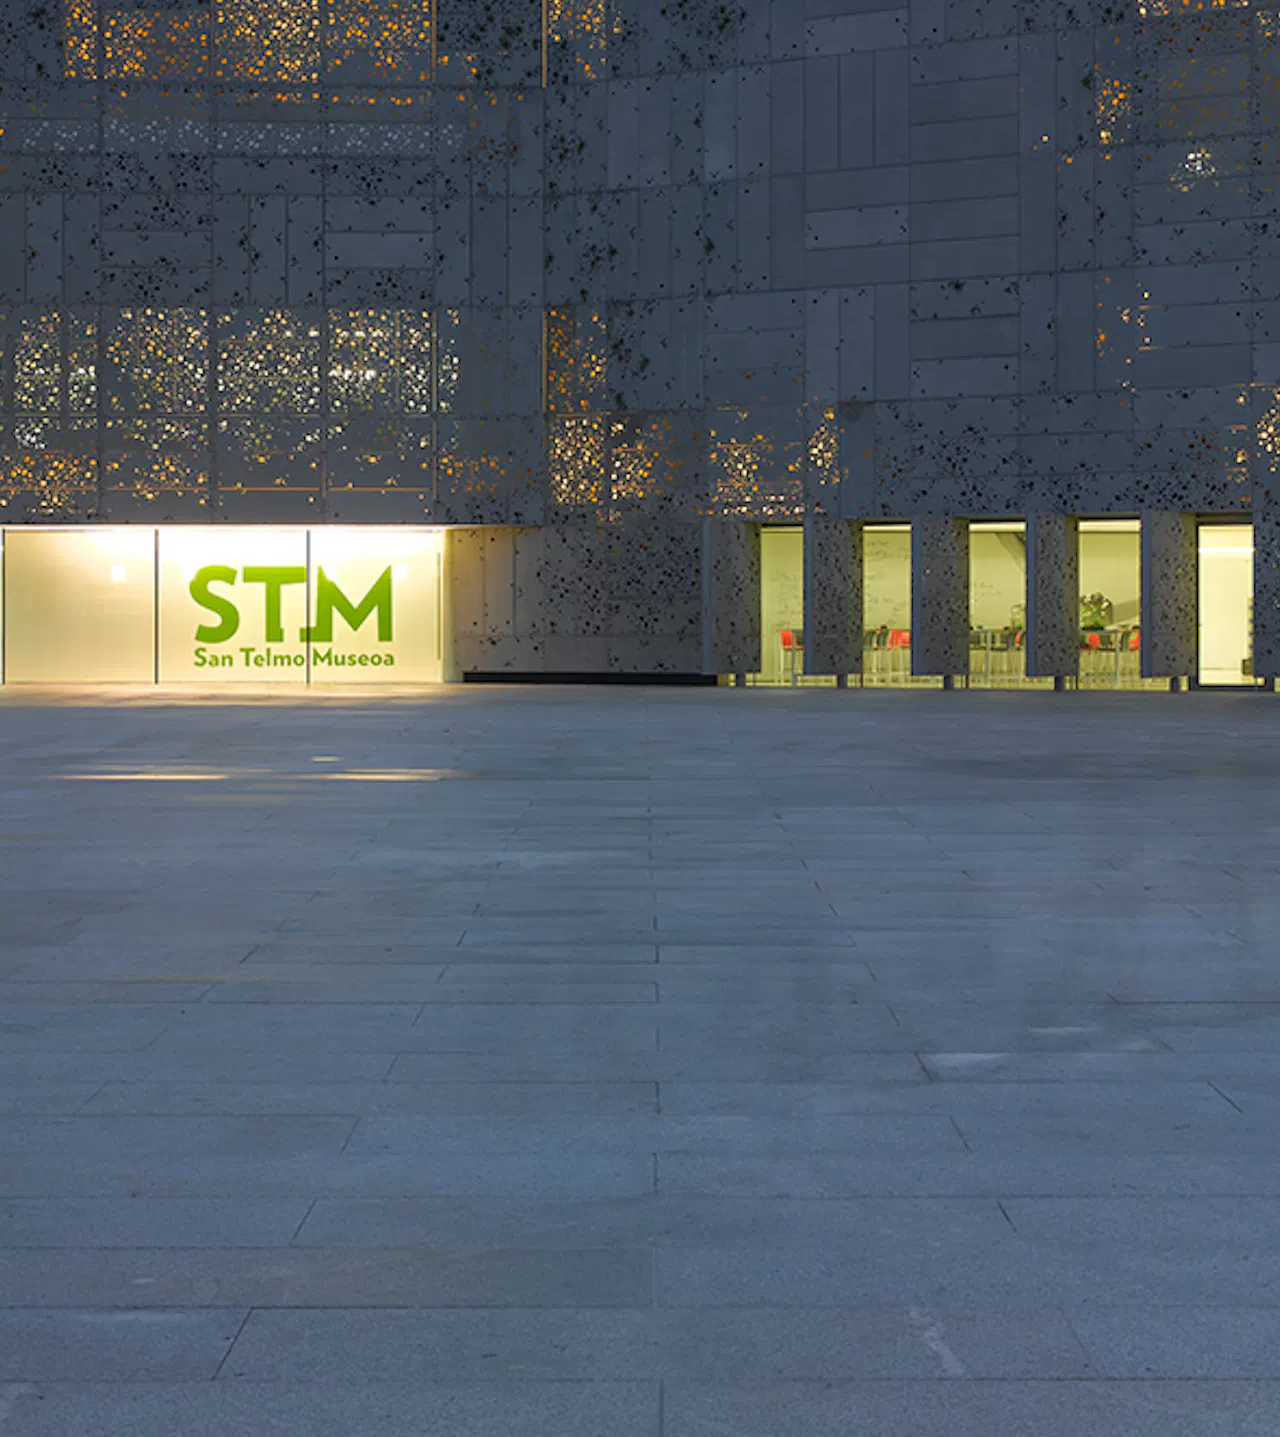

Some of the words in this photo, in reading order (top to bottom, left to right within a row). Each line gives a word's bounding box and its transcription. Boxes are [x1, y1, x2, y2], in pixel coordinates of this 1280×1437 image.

[189, 565, 393, 644] STM
[193, 647, 234, 668] San
[240, 647, 305, 668] Telmo
[312, 647, 395, 668] Museoa
